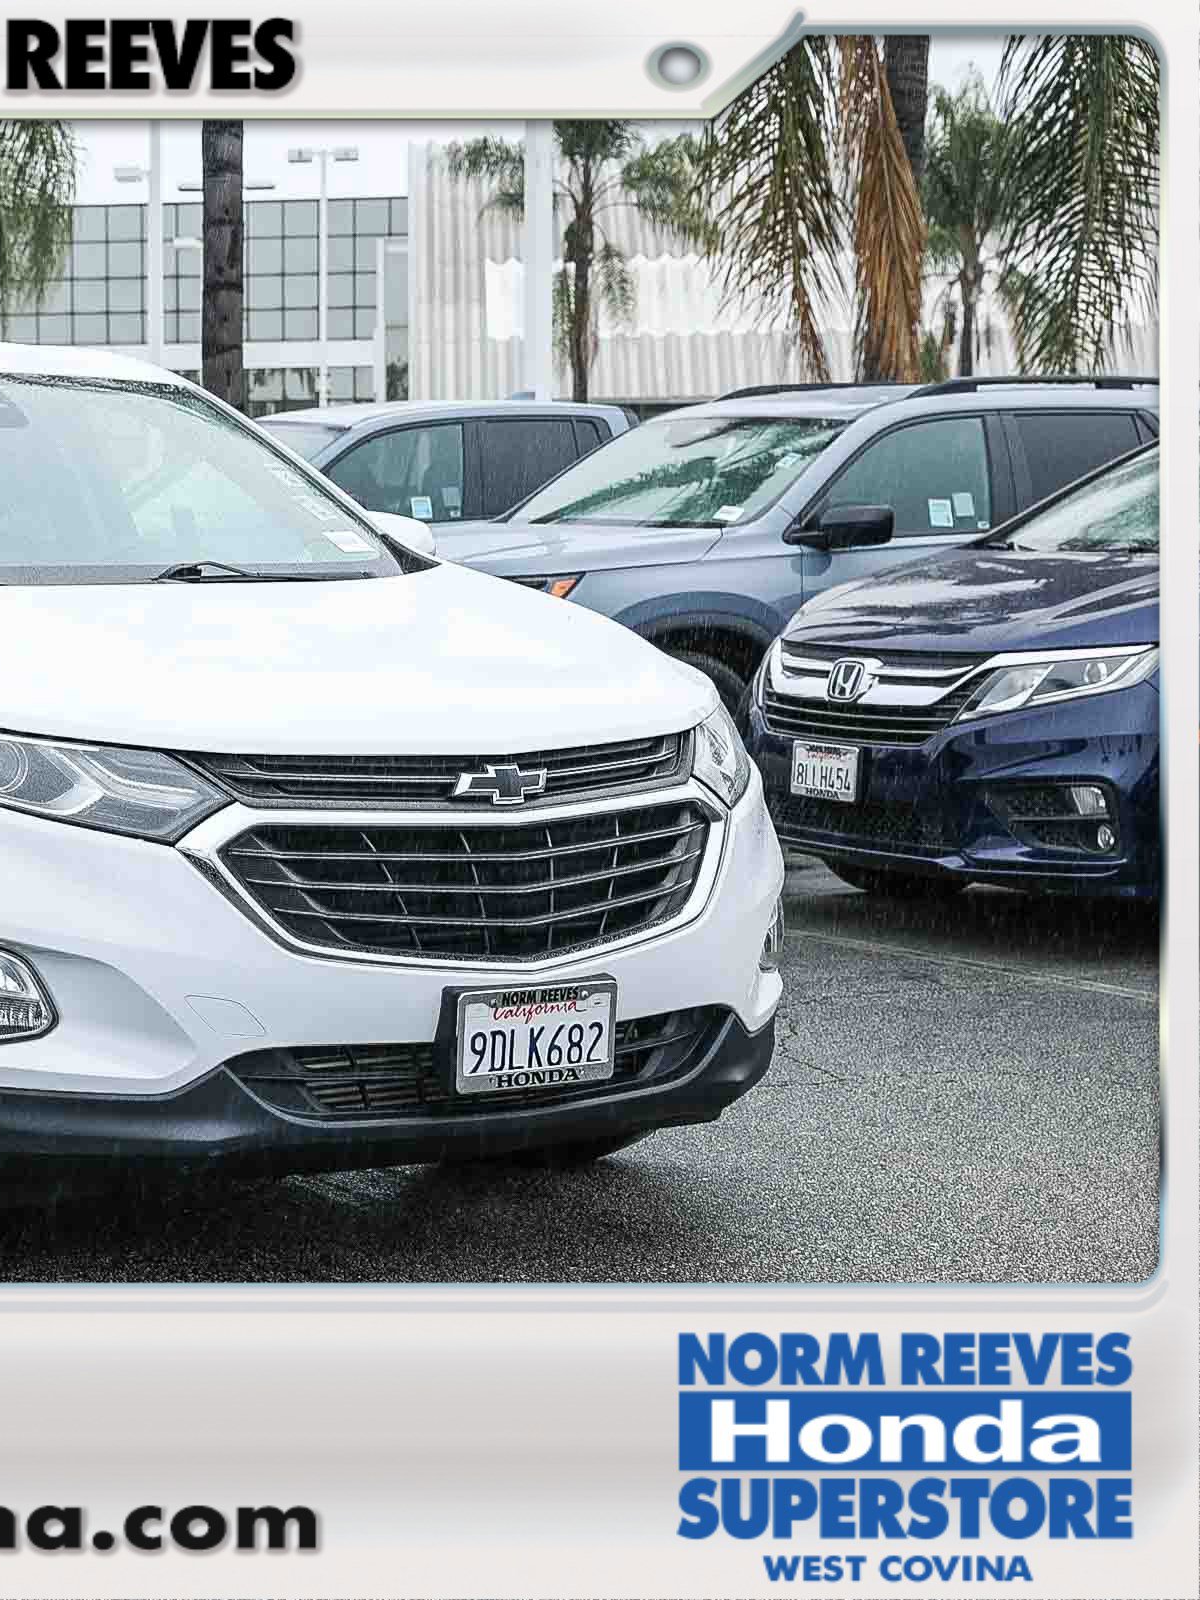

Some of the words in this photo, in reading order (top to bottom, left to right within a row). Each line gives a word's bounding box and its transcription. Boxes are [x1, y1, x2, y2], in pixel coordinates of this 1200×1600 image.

[806, 787, 840, 800] HONDA
[501, 990, 537, 1006] NORM
[541, 987, 579, 1003] REEVES
[492, 999, 587, 1024] California
[469, 1021, 604, 1074] 9DLK682
[495, 1067, 580, 1088] HONDA
